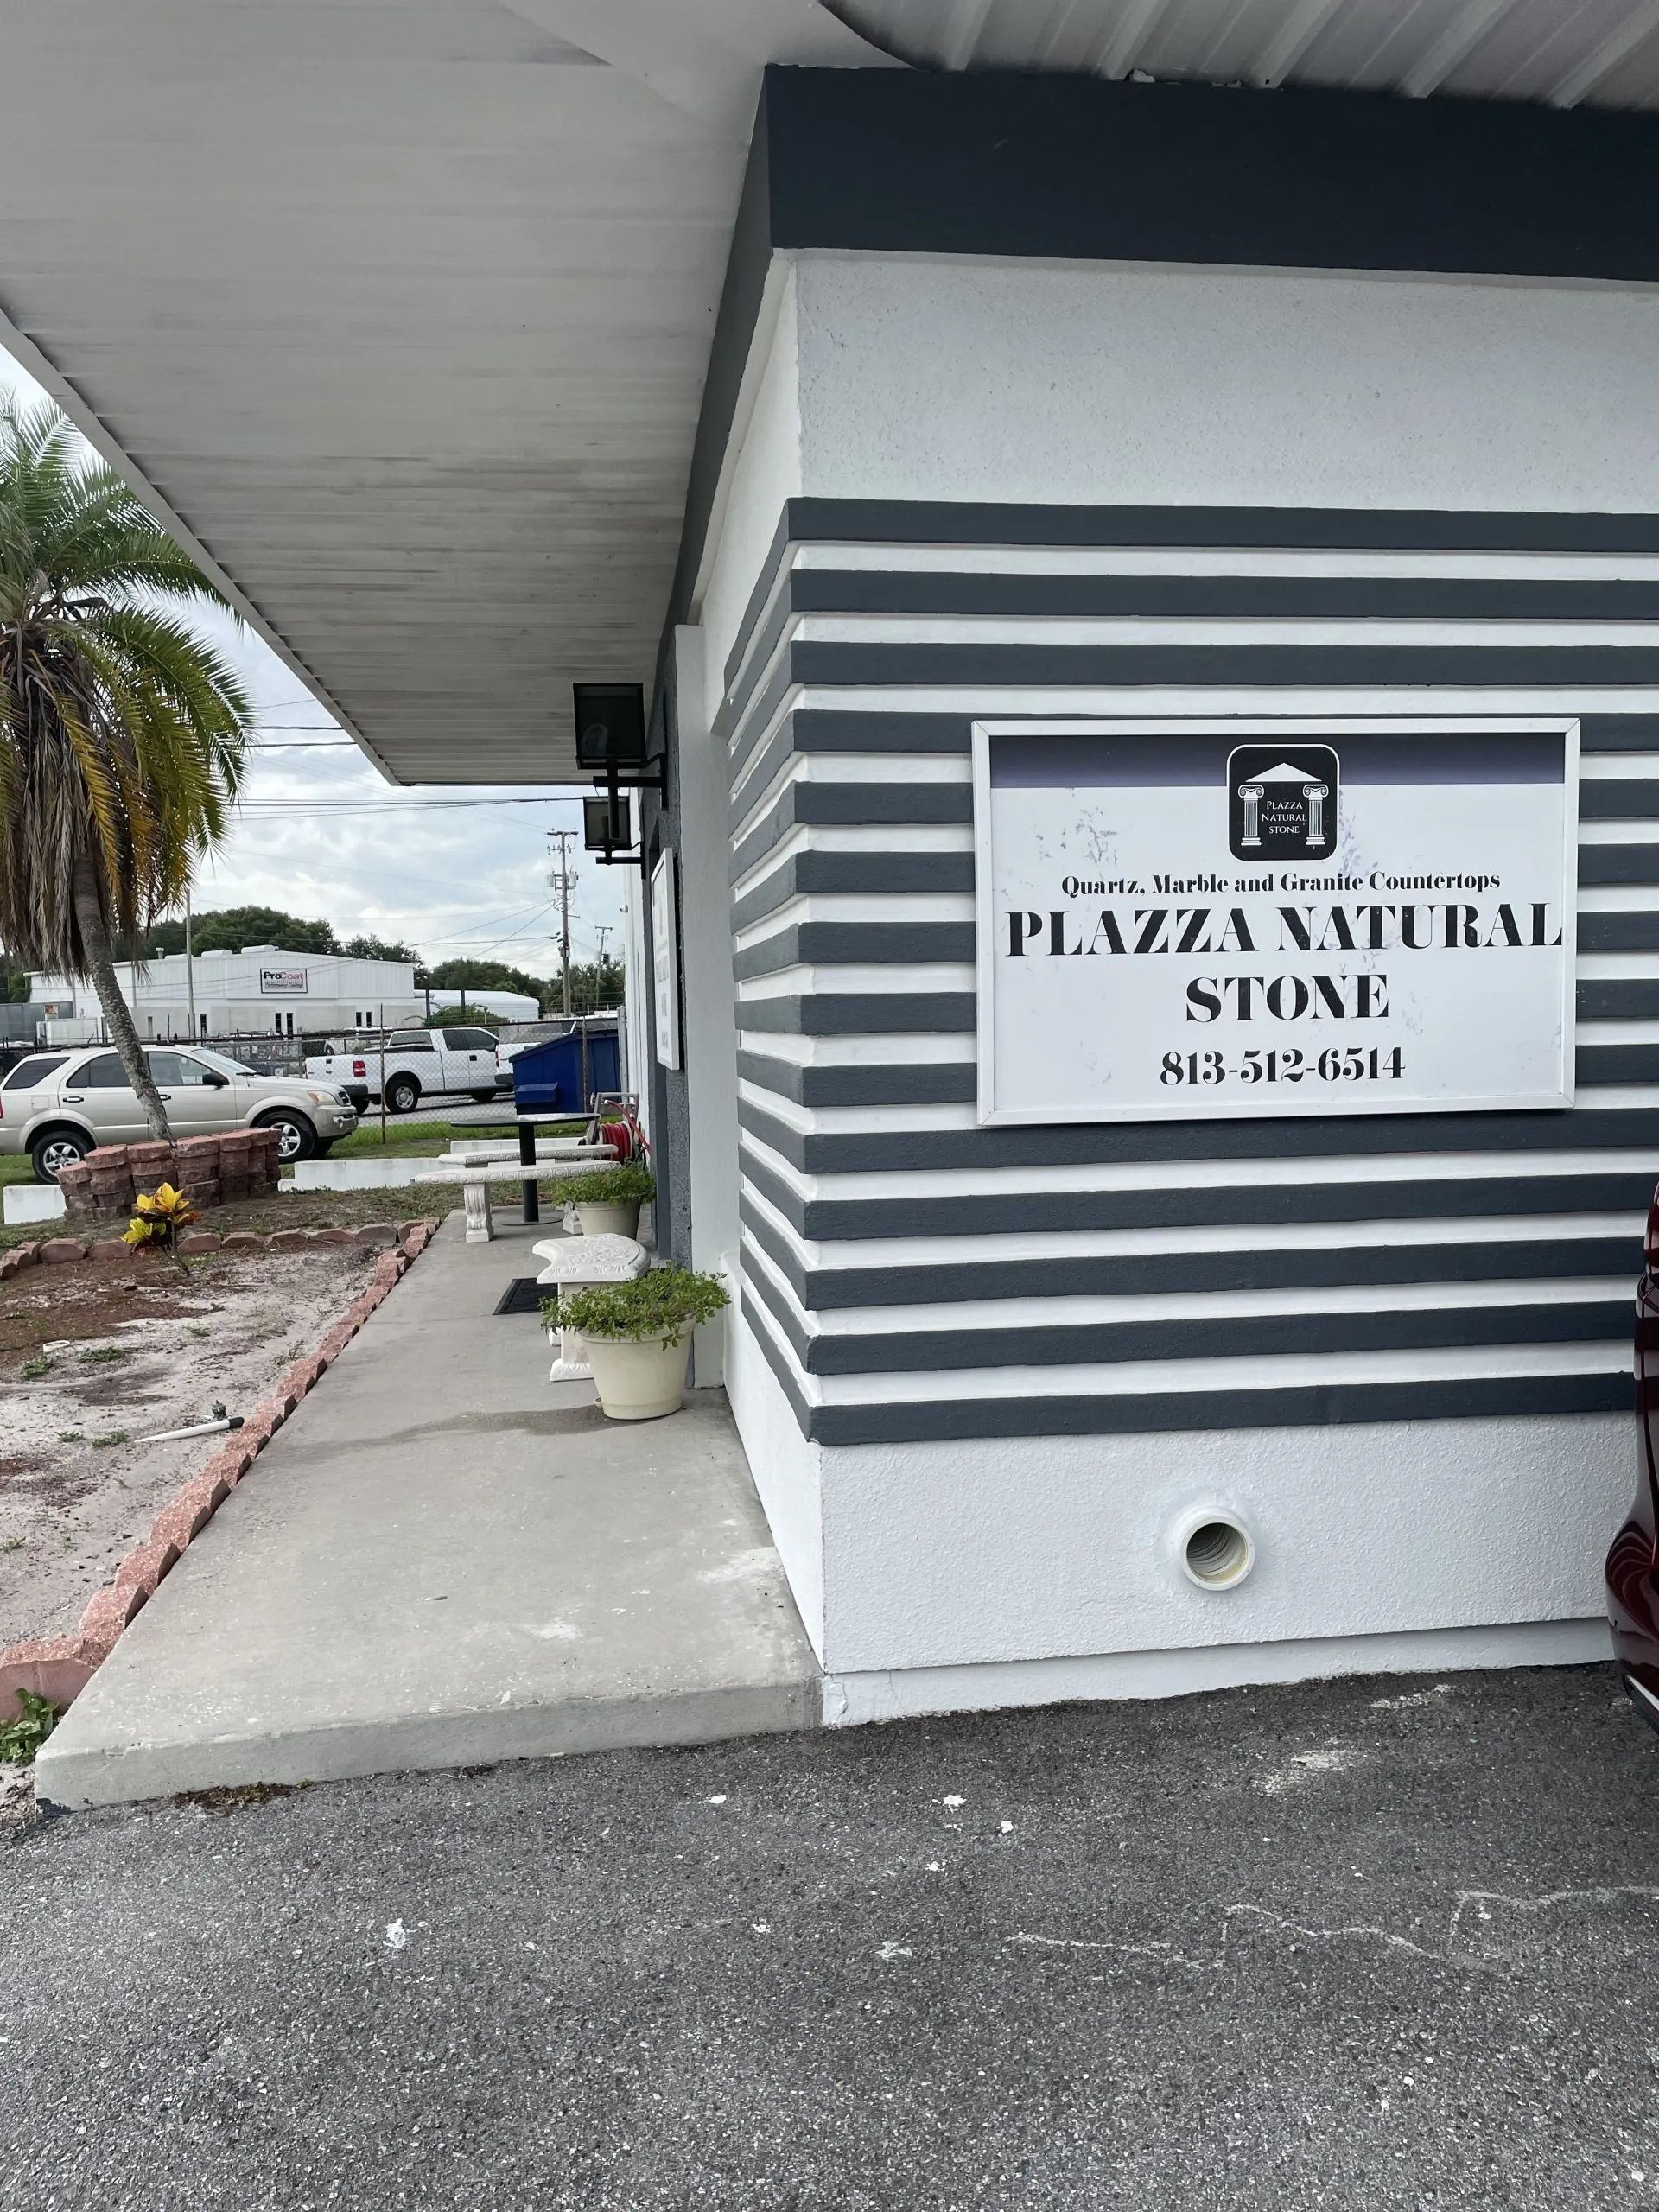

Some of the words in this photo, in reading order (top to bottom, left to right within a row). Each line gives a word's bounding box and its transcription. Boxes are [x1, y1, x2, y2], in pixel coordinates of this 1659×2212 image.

[1266, 800, 1303, 810] PLAZZA
[1262, 813, 1307, 822] NATURAL
[1268, 825, 1300, 834] STONE
[1061, 875, 1146, 899] Quartz,
[1152, 874, 1229, 893] Marble
[1234, 873, 1274, 893] and
[1280, 872, 1363, 892] Granite
[1369, 871, 1501, 893] Countertops
[1004, 907, 1260, 957] PLAZZA
[1275, 902, 1563, 951] NATURAL
[264, 971, 304, 980] ProCoat
[1185, 974, 1389, 1023] STONE
[1160, 1046, 1407, 1086] 813-512-6514
